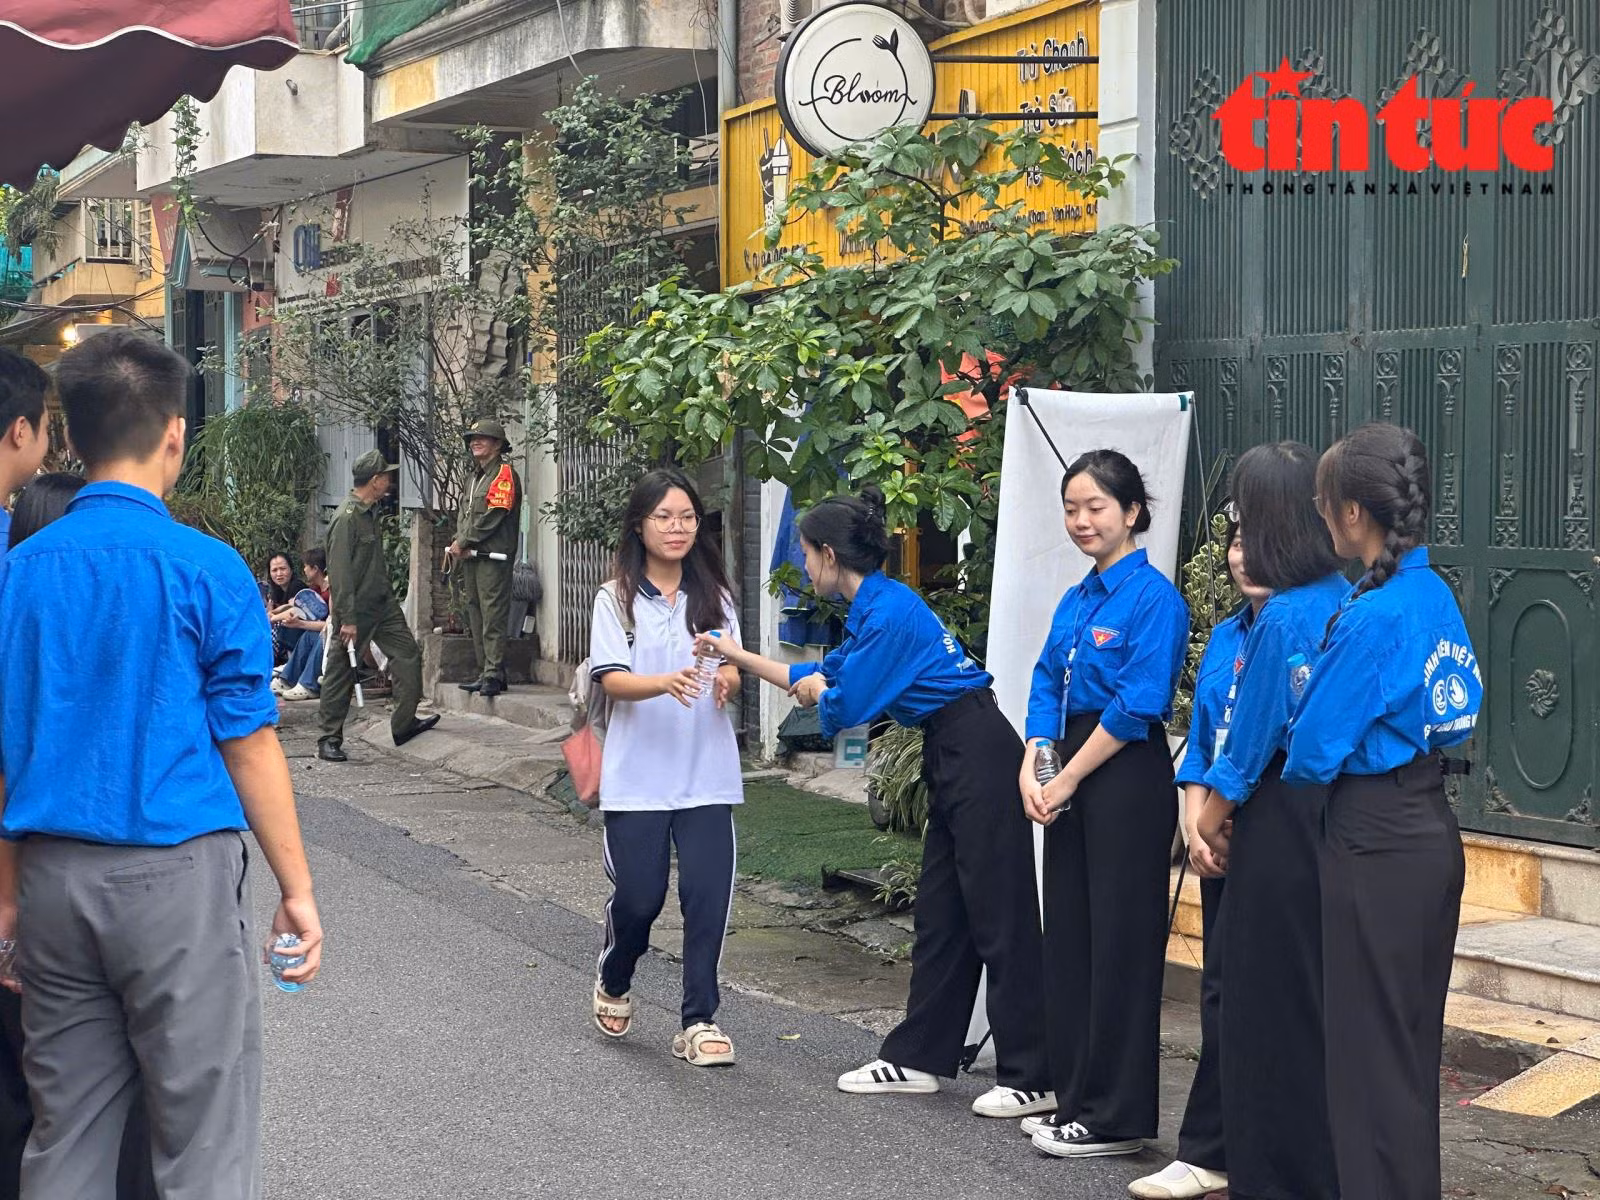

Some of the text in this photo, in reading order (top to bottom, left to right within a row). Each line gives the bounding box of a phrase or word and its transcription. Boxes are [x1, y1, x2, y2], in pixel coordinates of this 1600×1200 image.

[1043, 29, 1087, 75] Chanh
[818, 72, 906, 105] Bloom
[1059, 139, 1095, 175] ách
